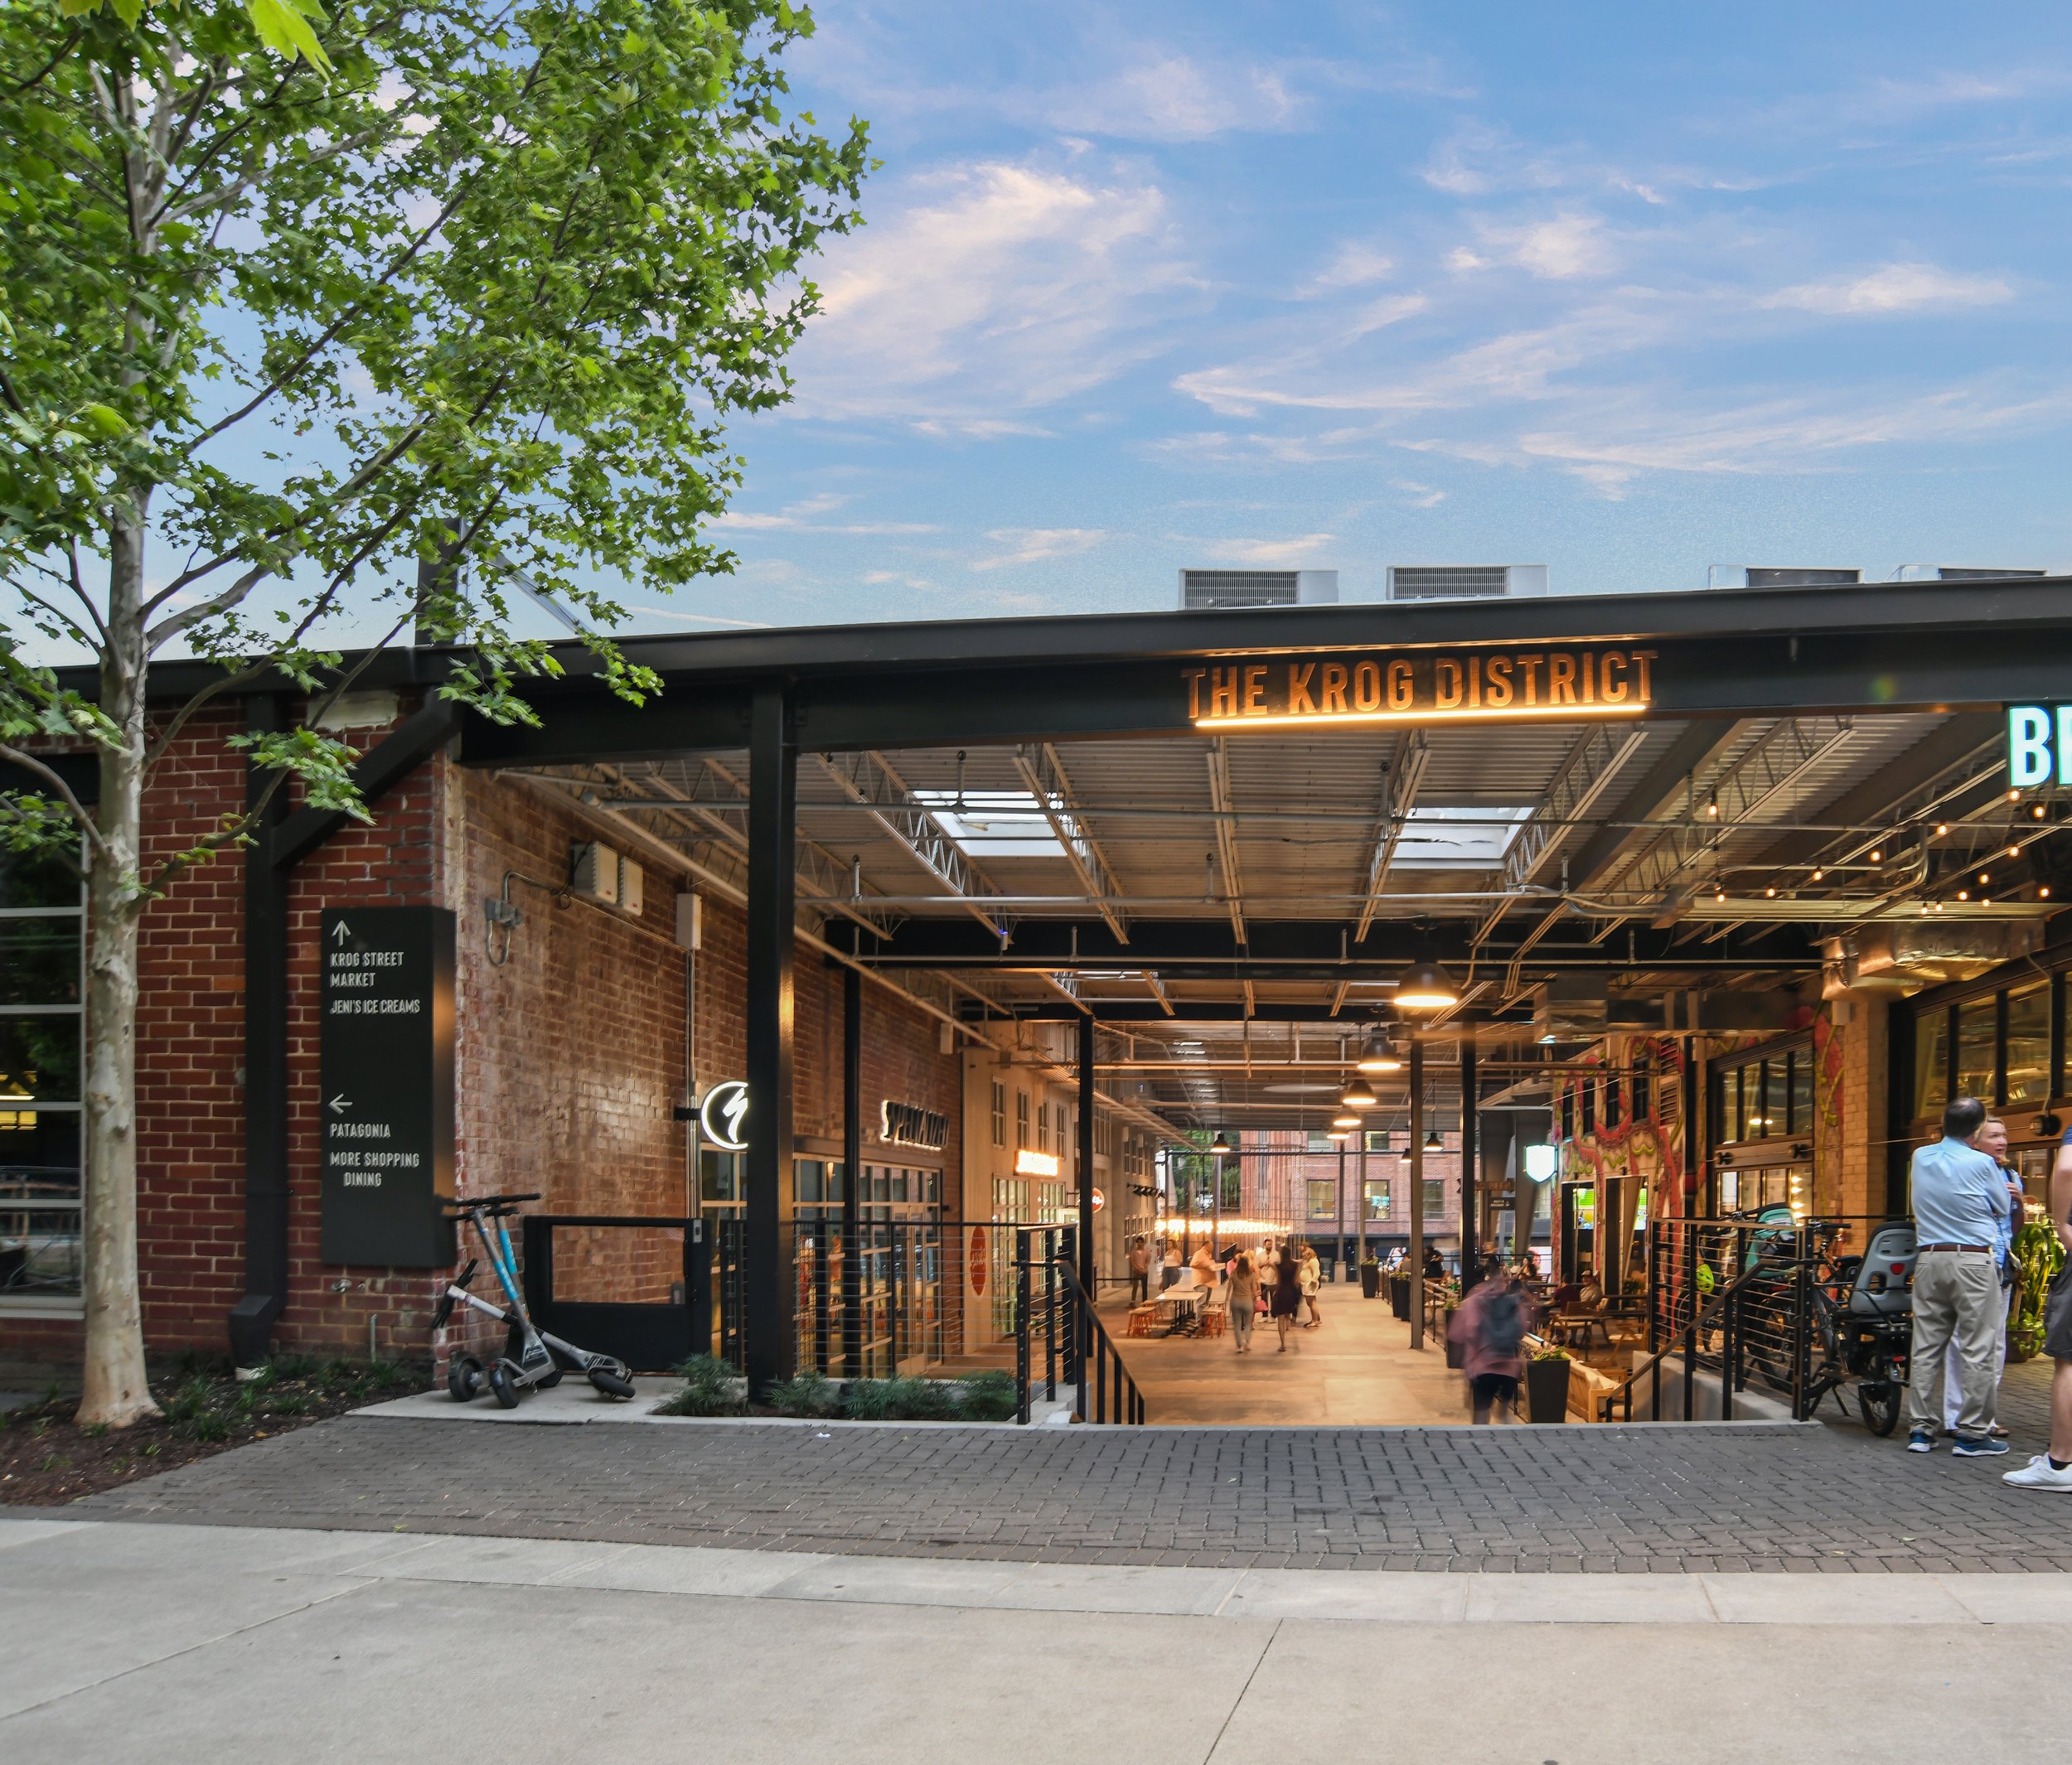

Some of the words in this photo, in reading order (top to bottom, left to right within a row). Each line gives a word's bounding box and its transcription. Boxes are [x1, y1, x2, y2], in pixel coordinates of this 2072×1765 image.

[1181, 664, 1268, 719] THE
[1288, 658, 1414, 714] KROG
[1435, 650, 1658, 708] DISTRICT
[330, 952, 360, 968] KROG
[362, 951, 404, 967] STREET
[330, 972, 376, 988] MARKET
[330, 999, 362, 1014] JENI'S
[363, 999, 379, 1014] ICE
[380, 999, 421, 1014] CREAMS
[330, 1123, 391, 1139] PATAGONIA
[330, 1151, 361, 1167] MORE
[363, 1152, 420, 1168] SHOPPING
[343, 1172, 382, 1187] DINING
